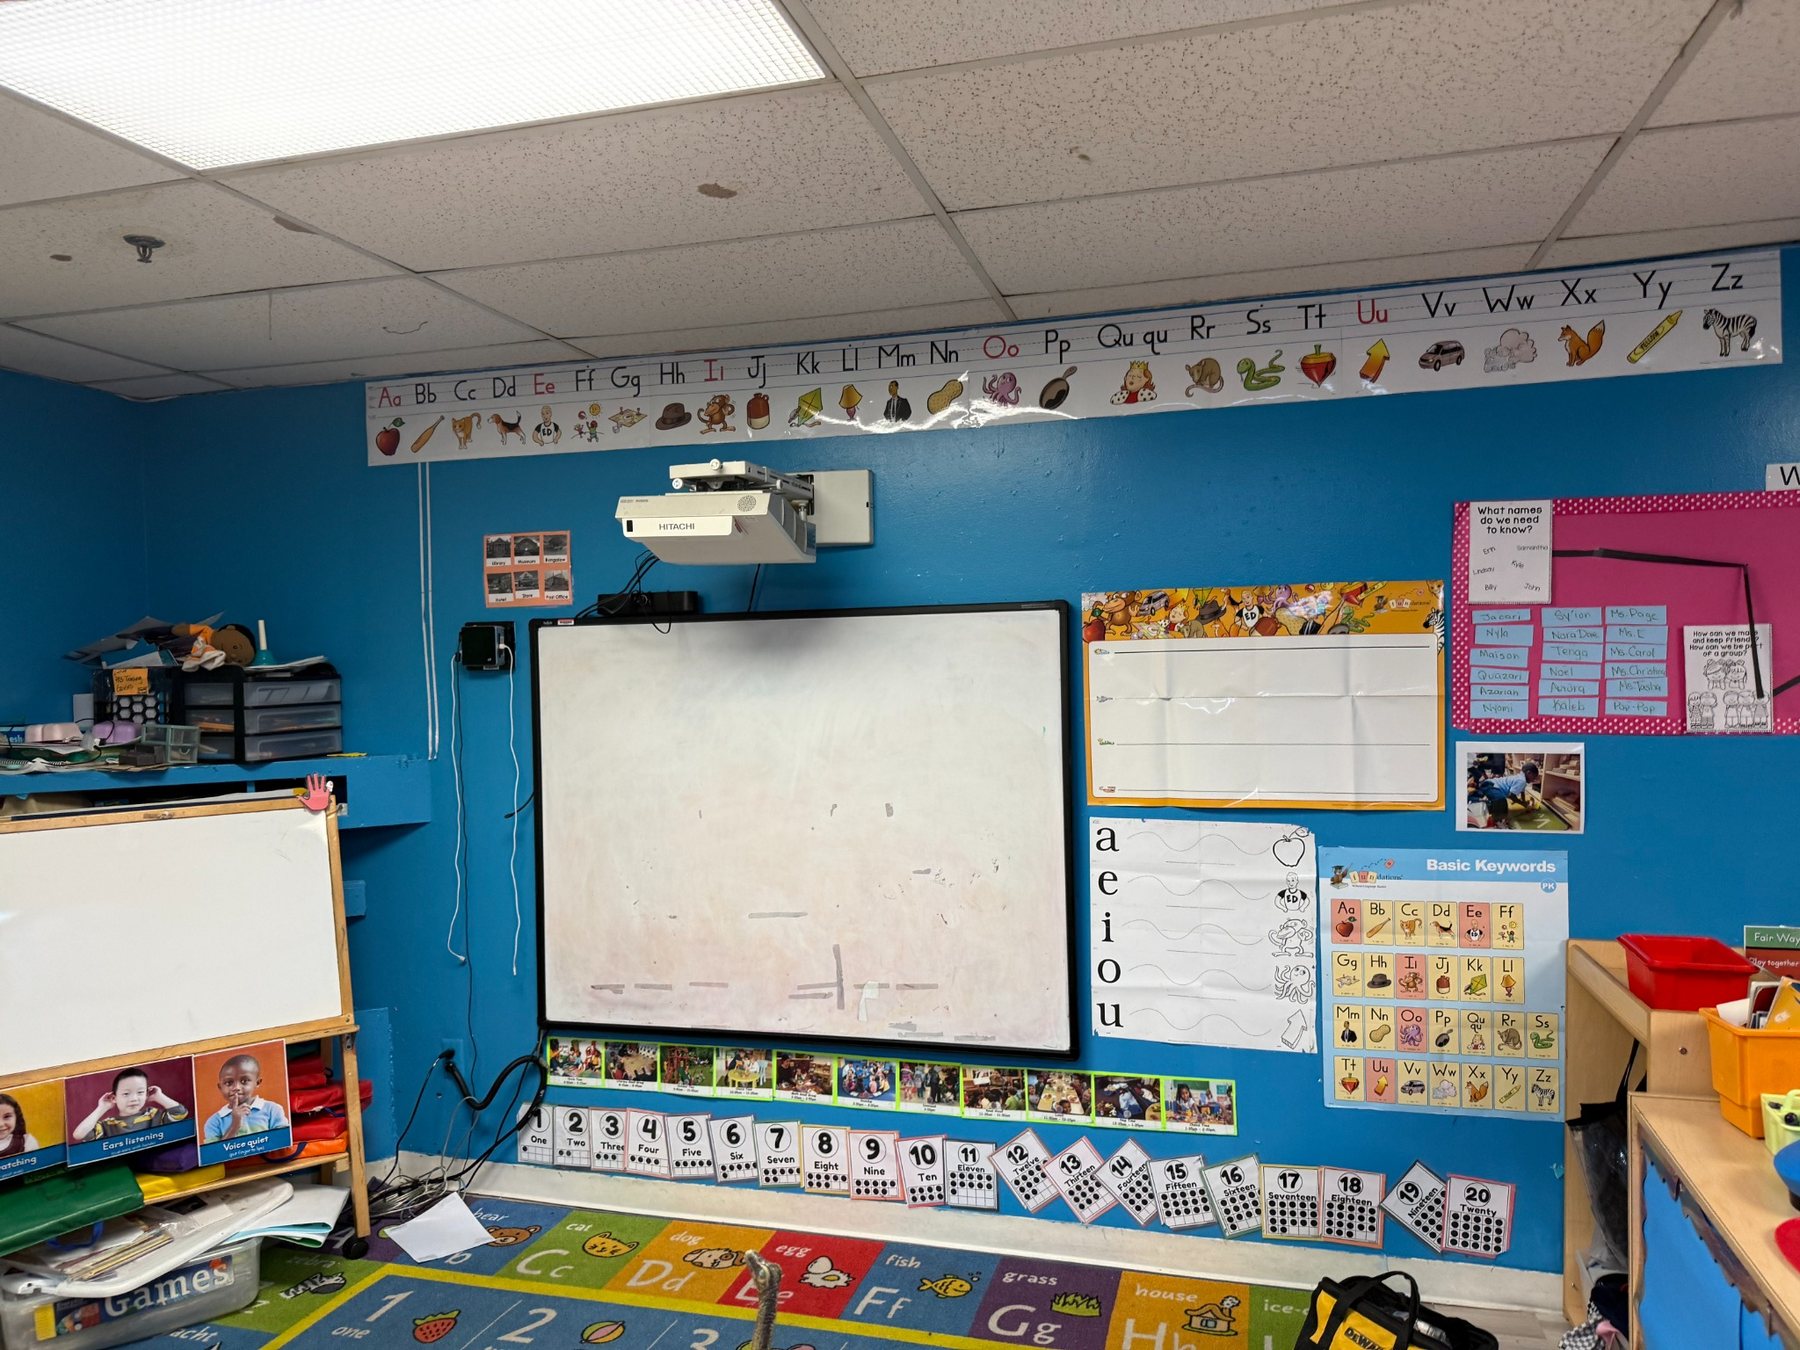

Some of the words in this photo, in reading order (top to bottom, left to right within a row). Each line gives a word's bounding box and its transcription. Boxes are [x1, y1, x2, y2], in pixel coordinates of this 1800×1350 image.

[379, 387, 401, 408] Aa
[415, 383, 436, 404] Bb
[454, 380, 476, 400] Cc
[493, 376, 515, 398] Dd
[534, 373, 554, 395] Ee
[576, 369, 595, 391] Ff
[611, 366, 640, 397] Gg
[661, 362, 684, 384] Hh
[704, 359, 723, 381] Ii
[748, 355, 765, 388] Jj
[797, 351, 819, 375] Kk
[843, 348, 858, 371] Ll
[879, 344, 915, 368] Mm
[931, 340, 958, 364] Nn
[984, 334, 1019, 358] Oo
[1046, 329, 1070, 364] Pp
[1098, 324, 1133, 348] Qu
[1143, 330, 1167, 355] qu
[1191, 315, 1215, 340] Rr
[1247, 309, 1271, 334] Ss
[1298, 304, 1326, 329] Tt
[1358, 299, 1387, 324] Uu
[1422, 291, 1456, 317] Vv
[1483, 285, 1534, 313] Ww
[1561, 278, 1596, 306] Xx
[1633, 270, 1672, 309] Yy
[1712, 263, 1743, 291] Zz
[1500, 525, 1532, 533] know?
[1245, 612, 1256, 620] ED
[1096, 828, 1119, 851] a
[1427, 859, 1470, 870] Basic
[1476, 860, 1555, 874] Keywords
[1099, 872, 1117, 895] e
[1286, 894, 1298, 904] ED
[1542, 882, 1556, 890] PK
[1338, 902, 1354, 914] Aa
[1371, 903, 1385, 915] Bb
[1401, 904, 1417, 916] Cc
[1433, 904, 1450, 916] Dd
[1467, 905, 1482, 917] Ee
[1500, 906, 1514, 918] Ff
[1102, 912, 1113, 942] i
[1755, 933, 1773, 941] Fair
[1098, 959, 1120, 983] o
[1337, 954, 1357, 971] Gg
[1371, 955, 1387, 968] Hh
[1405, 956, 1416, 969] Ii
[1436, 957, 1449, 974] Jj
[1468, 959, 1482, 971] Kk
[1503, 960, 1512, 972] Ll
[1097, 1003, 1123, 1027] u
[1337, 1007, 1359, 1019] Mm
[1371, 1008, 1388, 1020] Nn
[1401, 1010, 1422, 1022] Oo
[1436, 1011, 1450, 1027] Pp
[1468, 1013, 1485, 1026] Qu
[1502, 1014, 1515, 1026] Rr
[1536, 1015, 1549, 1028] Ss
[1470, 1024, 1482, 1032] qu
[1342, 1059, 1356, 1070] Tt
[1373, 1061, 1388, 1072] Uu
[1404, 1062, 1420, 1074] Vv
[1433, 1064, 1456, 1076] Ww
[1469, 1066, 1485, 1078] Xx
[1502, 1068, 1518, 1084] Yy
[1536, 1070, 1551, 1082] Zz
[532, 1109, 541, 1128] 1
[568, 1112, 582, 1132] 2
[605, 1116, 619, 1136] 3
[642, 1118, 658, 1140] 4
[683, 1120, 695, 1142] 5
[726, 1123, 740, 1144] 6
[770, 1128, 784, 1148] 7
[102, 1140, 124, 1151] Ears
[125, 1131, 164, 1146] listening
[223, 1142, 246, 1152] Voice
[247, 1136, 269, 1148] quiet
[531, 1136, 547, 1144] One
[567, 1138, 586, 1148] Two
[600, 1141, 625, 1151] Three
[638, 1144, 660, 1154] Four
[818, 1132, 834, 1154] 8
[682, 1148, 702, 1157] Five
[730, 1152, 744, 1160] Six
[866, 1139, 879, 1160] 9
[910, 1144, 936, 1164] 10
[961, 1147, 976, 1163] 11
[1008, 1144, 1028, 1164] 12
[767, 1155, 794, 1164] Seven
[814, 1161, 839, 1172] Eight
[1013, 1155, 1040, 1176] Twelve
[1059, 1154, 1081, 1172] 13
[1110, 1156, 1132, 1176] 14
[864, 1166, 885, 1176] Nine
[918, 1173, 936, 1182] Ten
[957, 1165, 985, 1173] Eleven
[1064, 1164, 1096, 1186] Thirteen
[1118, 1163, 1147, 1192] Fourteen
[1166, 1162, 1186, 1180] 15
[1221, 1166, 1243, 1184] 16
[1166, 1181, 1197, 1191] Fifteen
[1279, 1173, 1302, 1188] 17
[1339, 1177, 1362, 1193] 18
[1224, 1183, 1256, 1198] Sixteen
[1268, 1192, 1316, 1202] Seventeen
[1398, 1182, 1420, 1202] 19
[1466, 1186, 1489, 1202] 20
[1331, 1194, 1372, 1206] Eighteen
[1408, 1187, 1438, 1219] Nineteen
[473, 1208, 510, 1222] bear
[1460, 1204, 1498, 1217] Twenty
[567, 1221, 592, 1232] cat
[671, 1230, 705, 1248] dog
[775, 1244, 812, 1260] egg
[515, 1248, 574, 1278] Cc
[886, 1254, 922, 1270] fish
[626, 1260, 695, 1292] Dd
[1002, 1270, 1058, 1287] grass
[104, 1269, 234, 1317] Games
[1135, 1284, 1198, 1302] house
[366, 1291, 413, 1322] 1
[852, 1288, 912, 1320] Ff
[332, 1326, 370, 1338] one
[497, 1308, 558, 1344] 2
[987, 1304, 1062, 1342] Gg
